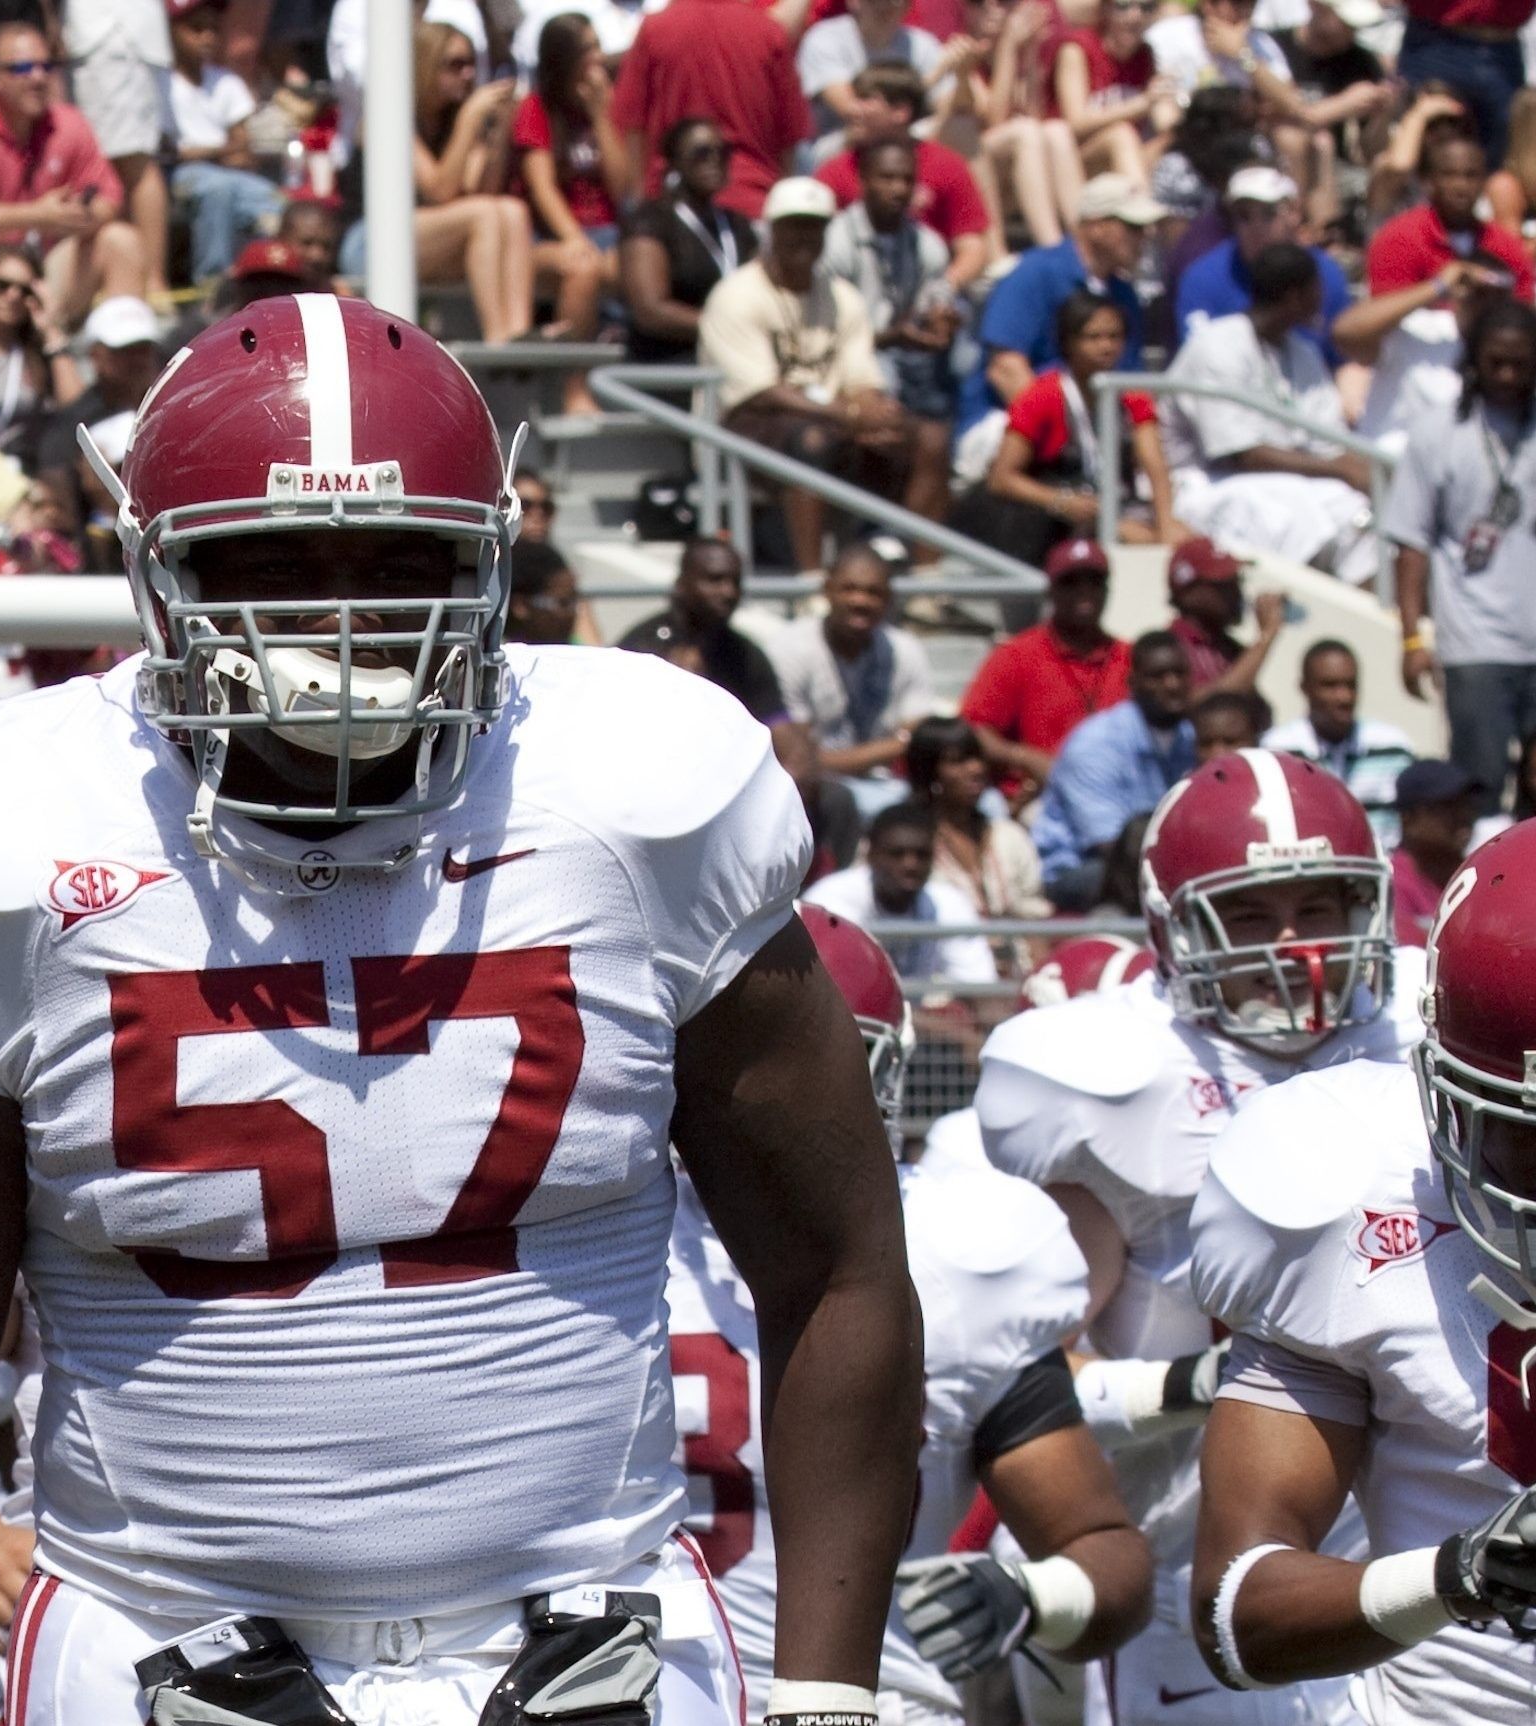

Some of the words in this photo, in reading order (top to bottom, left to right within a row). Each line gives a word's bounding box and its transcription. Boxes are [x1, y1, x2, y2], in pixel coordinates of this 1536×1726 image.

[301, 473, 371, 493] BAMA
[69, 867, 119, 909] SEC
[106, 945, 586, 1301] 57
[1375, 1217, 1420, 1257] SEC
